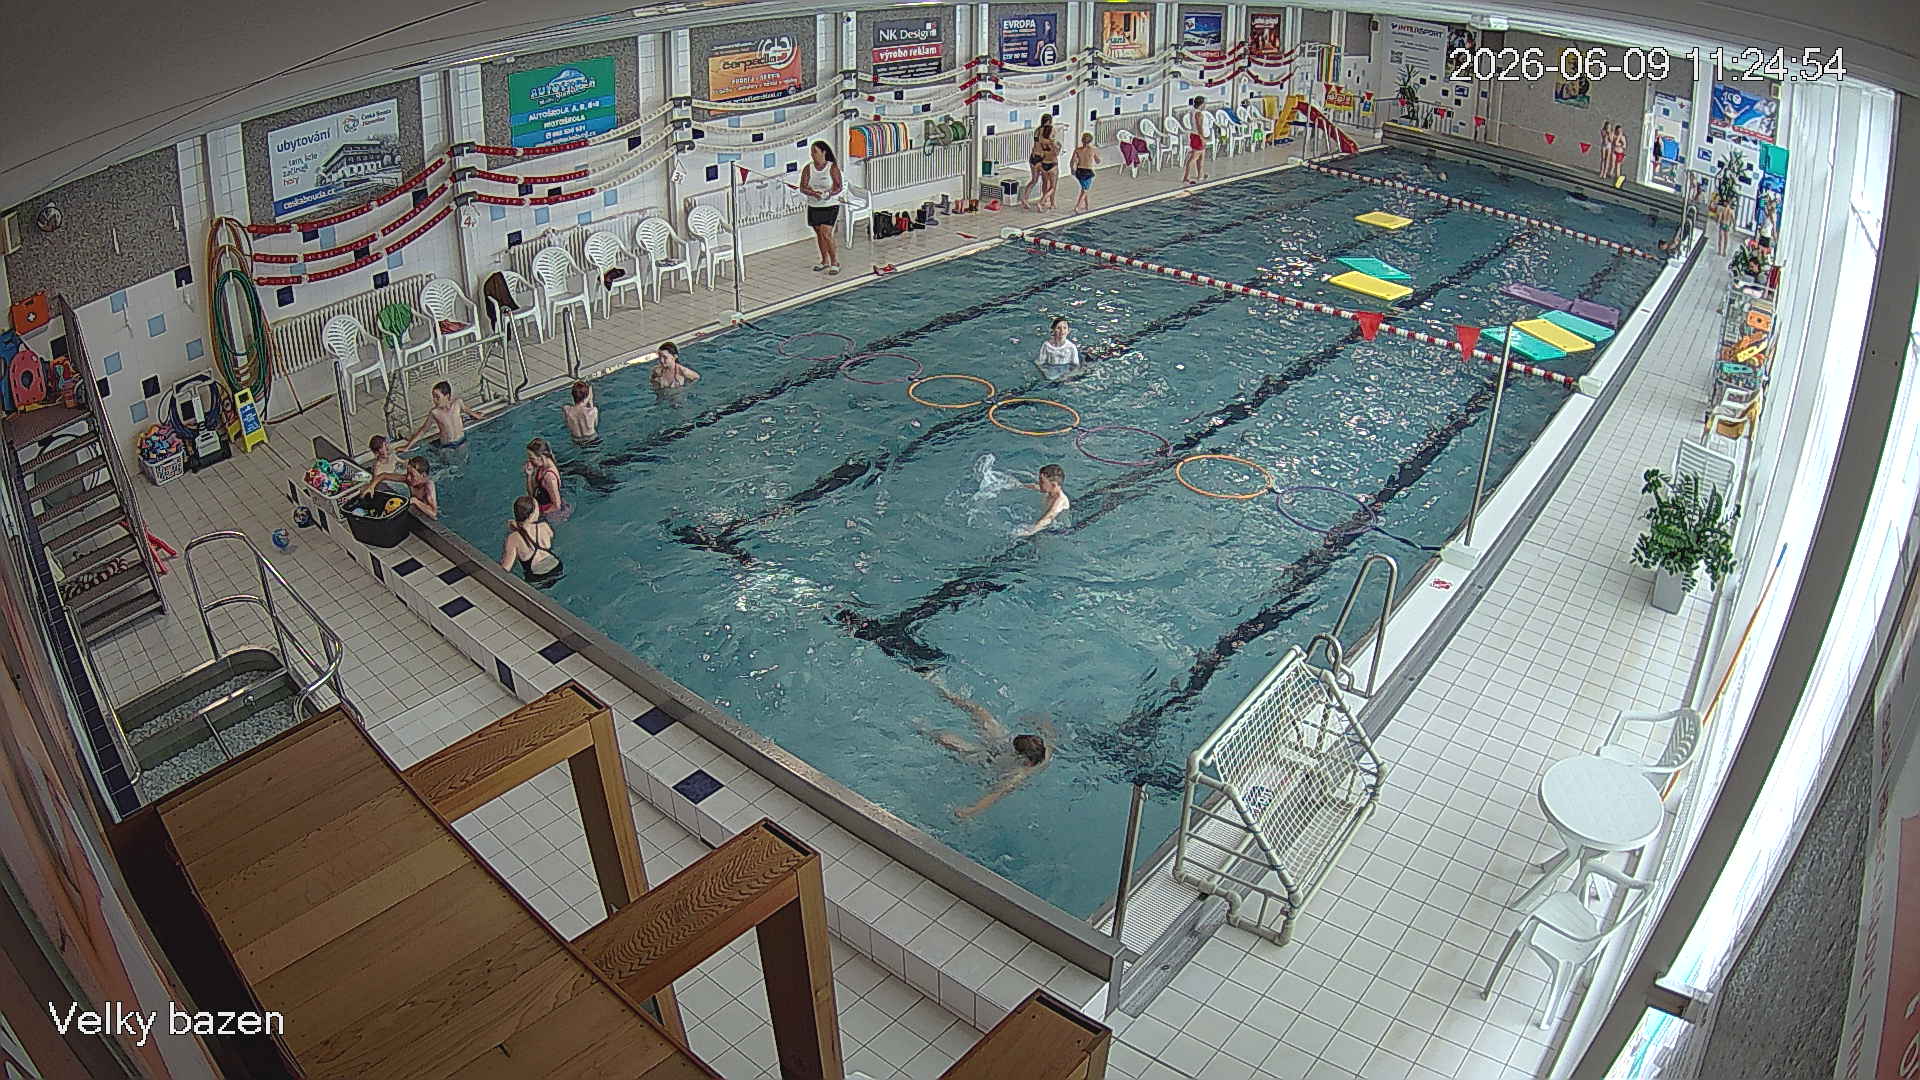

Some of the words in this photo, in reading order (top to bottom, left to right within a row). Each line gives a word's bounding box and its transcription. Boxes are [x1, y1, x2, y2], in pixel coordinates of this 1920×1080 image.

[1003, 19, 1036, 29] EVROPA
[879, 29, 897, 41] NK
[900, 27, 937, 40] Design
[528, 107, 570, 121] AUTOŠKOLA
[276, 127, 331, 153] ubytování
